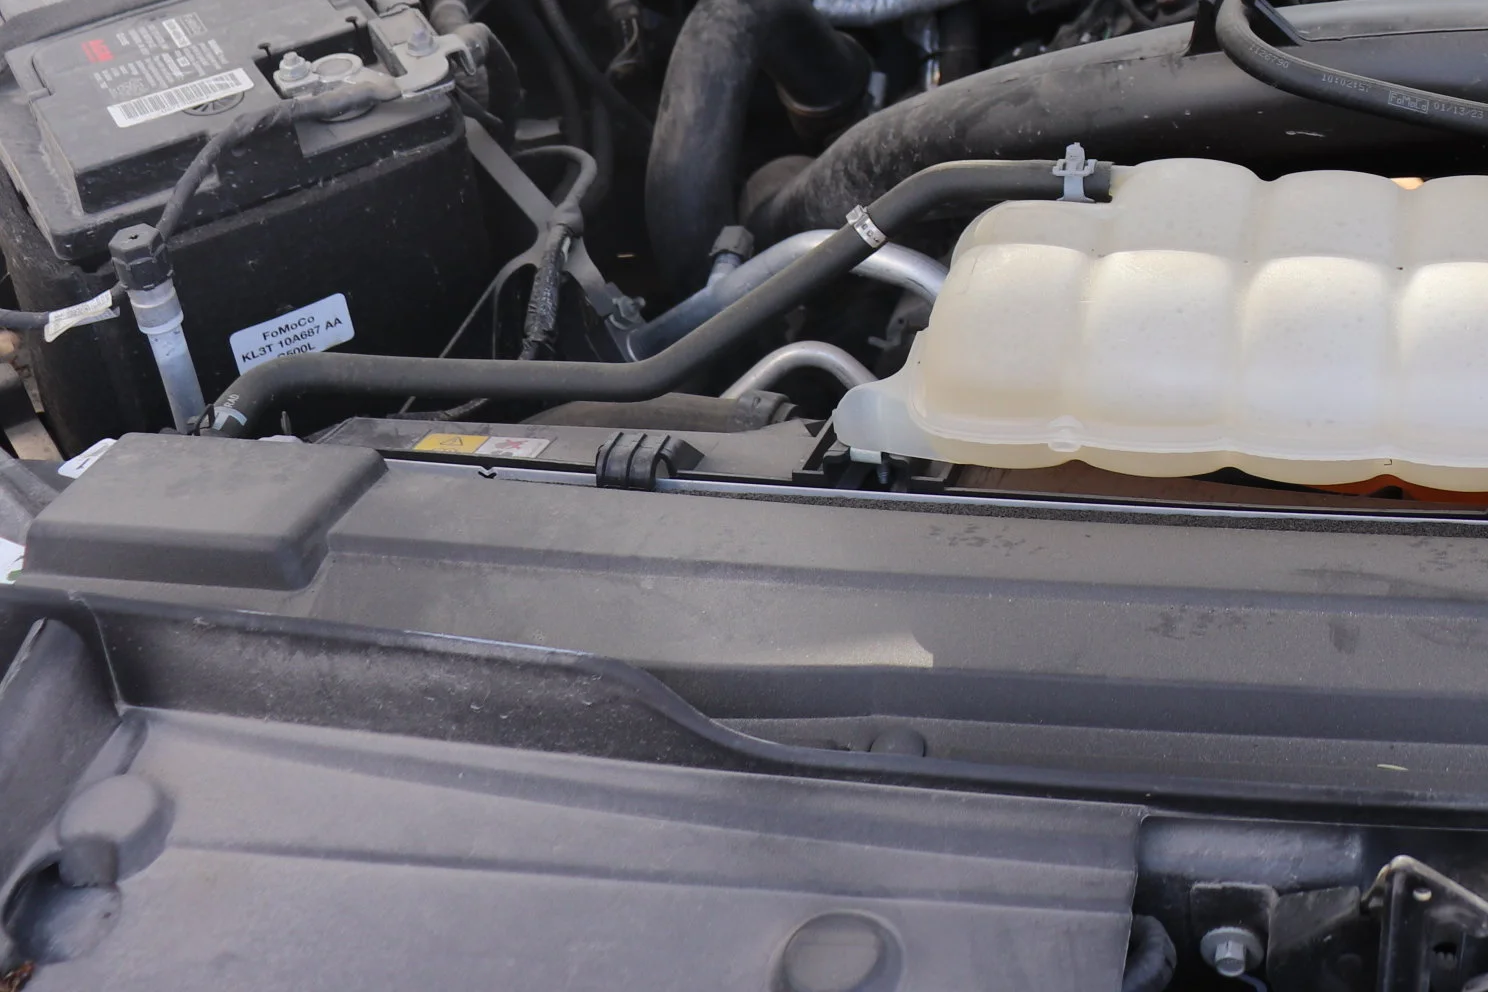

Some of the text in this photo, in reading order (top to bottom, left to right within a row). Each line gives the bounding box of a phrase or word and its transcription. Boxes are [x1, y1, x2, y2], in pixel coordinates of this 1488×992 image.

[241, 316, 343, 363] KL3T 10A687 AA
[262, 315, 316, 341] FoMoCo
